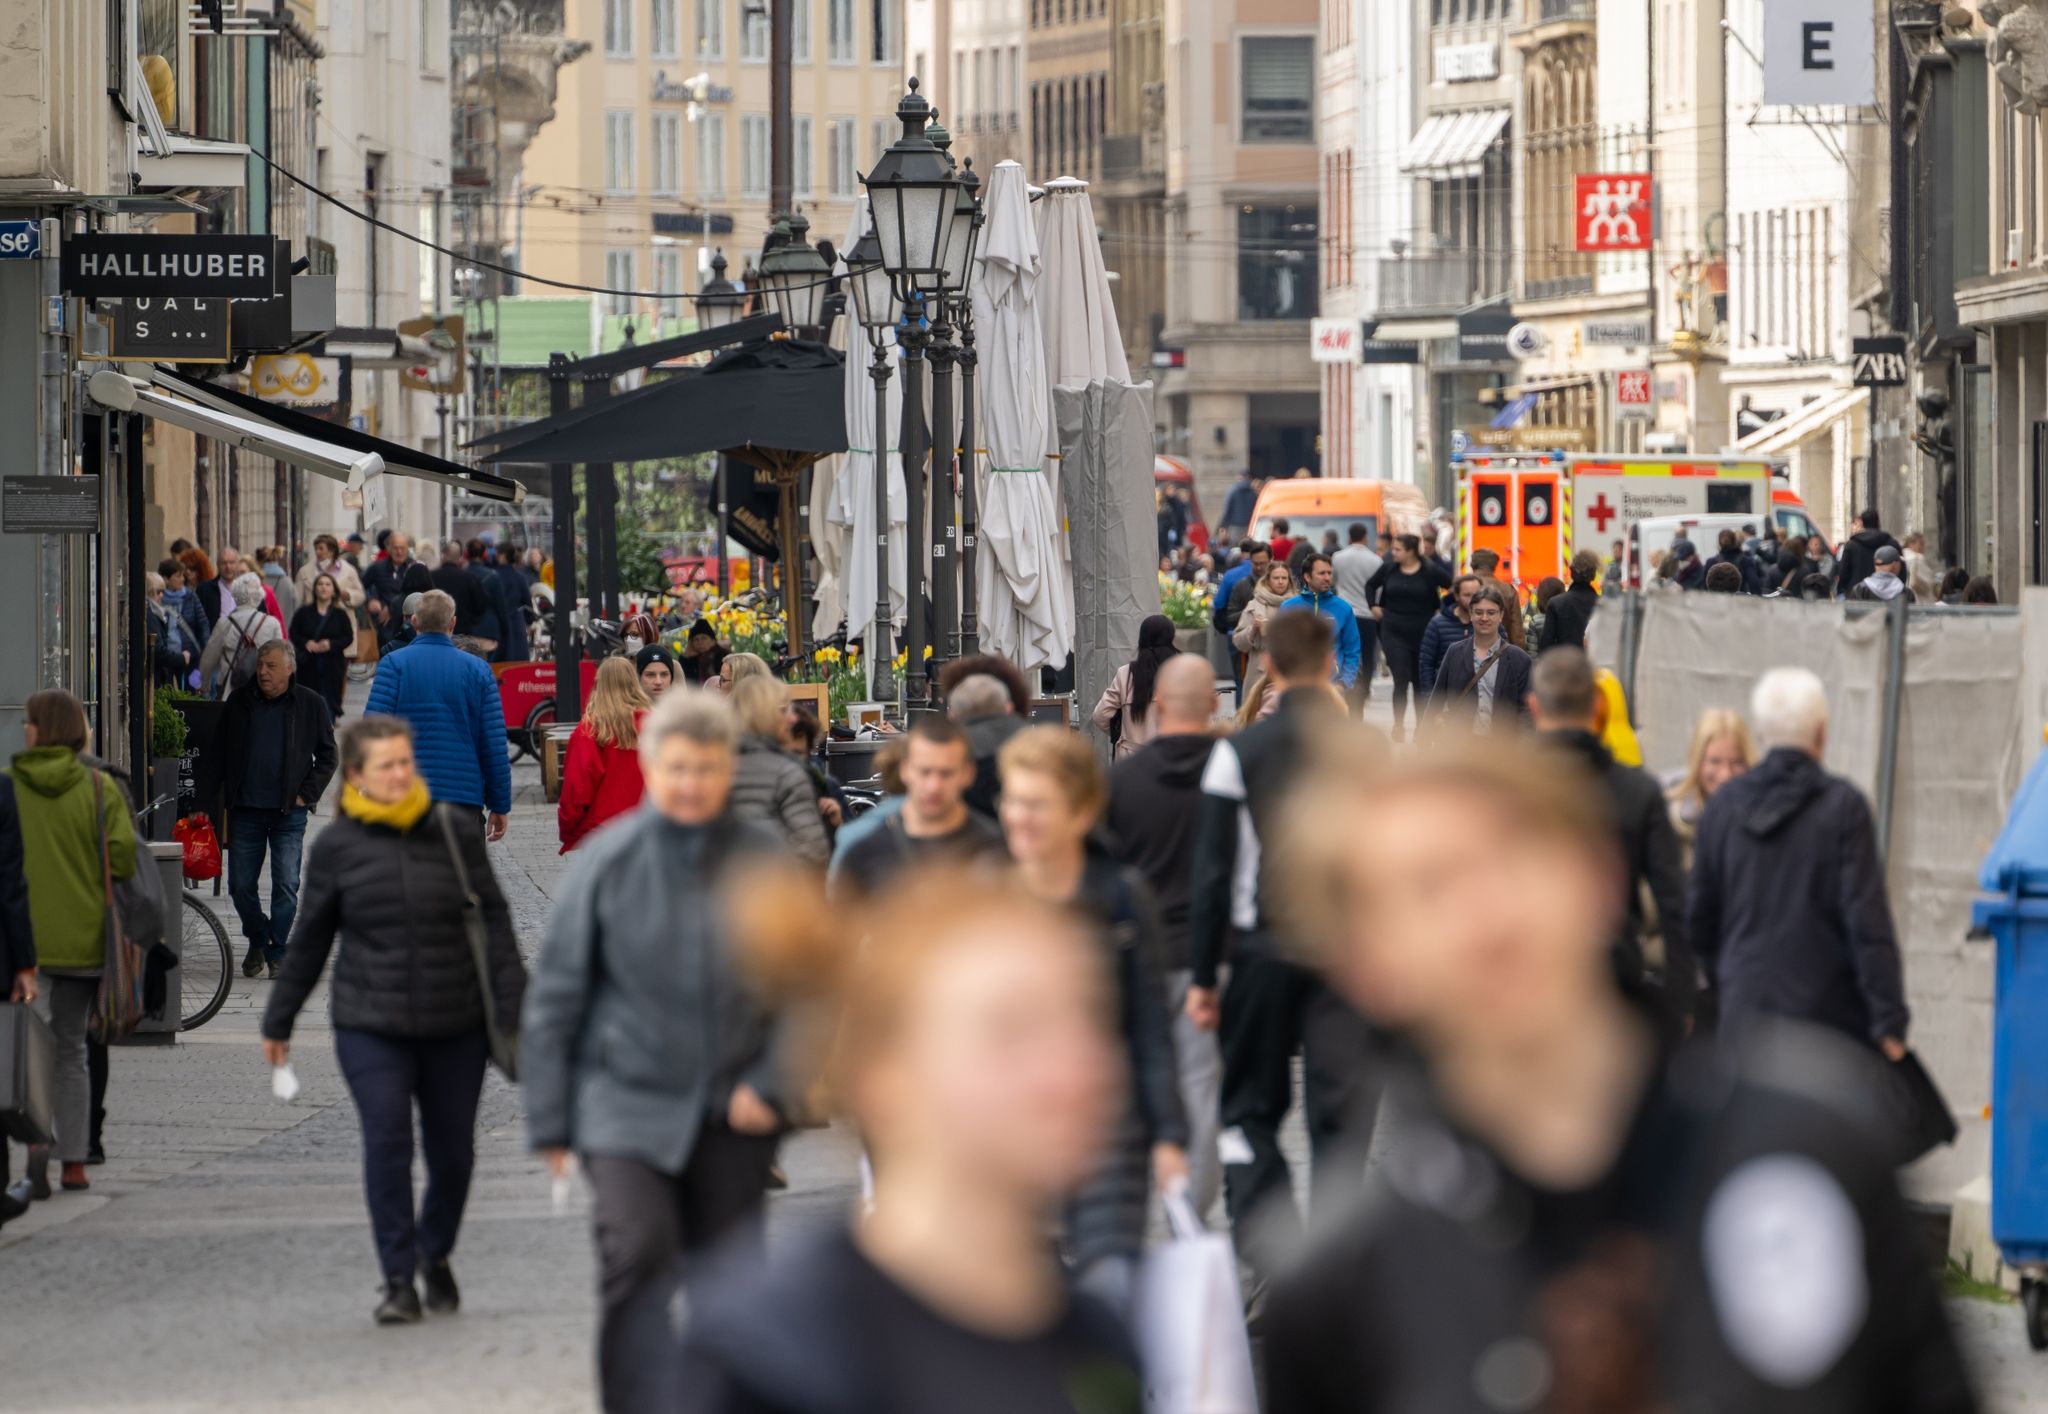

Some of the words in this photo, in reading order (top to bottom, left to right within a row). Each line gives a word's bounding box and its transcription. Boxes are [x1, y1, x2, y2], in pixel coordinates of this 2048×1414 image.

[1803, 21, 1834, 70] E
[79, 253, 266, 278] HALLHUBER
[1854, 352, 1906, 381] ZARA
[934, 546, 945, 555] 21
